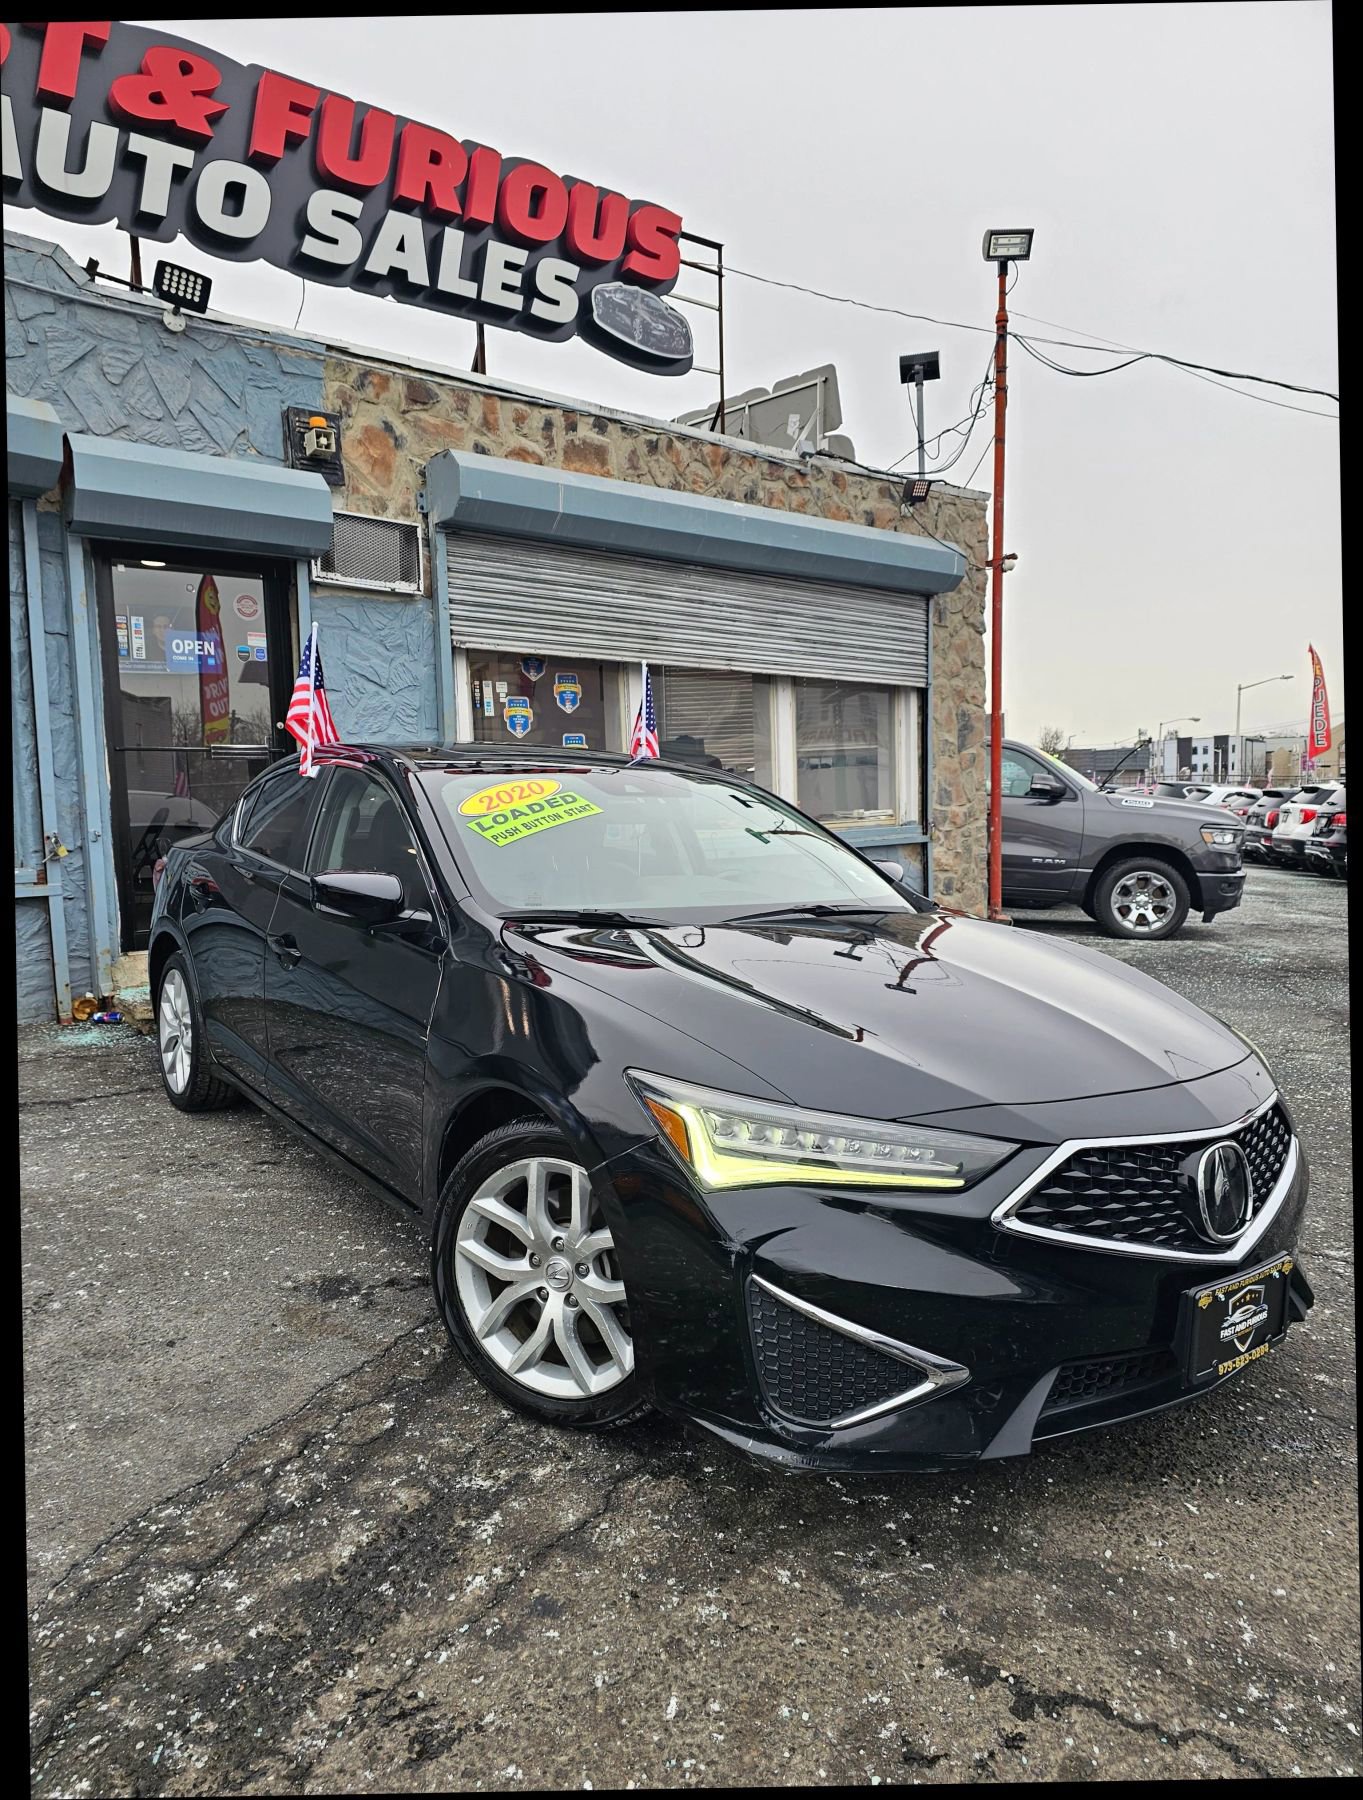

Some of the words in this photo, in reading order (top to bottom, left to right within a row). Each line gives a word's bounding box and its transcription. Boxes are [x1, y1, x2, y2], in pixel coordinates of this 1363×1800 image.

[108, 45, 231, 147] &
[248, 70, 683, 282] FURIOUS
[300, 189, 580, 324] SALES
[172, 639, 215, 656] OPEN
[475, 793, 578, 833] LOADED
[480, 781, 545, 812] 2020
[490, 826, 522, 843] PUSH
[520, 811, 564, 831] BUTTON
[563, 803, 594, 817] START
[1220, 1326, 1236, 1339] FAST
[1235, 1321, 1247, 1334] AND
[1246, 1310, 1268, 1327] FURIOUS
